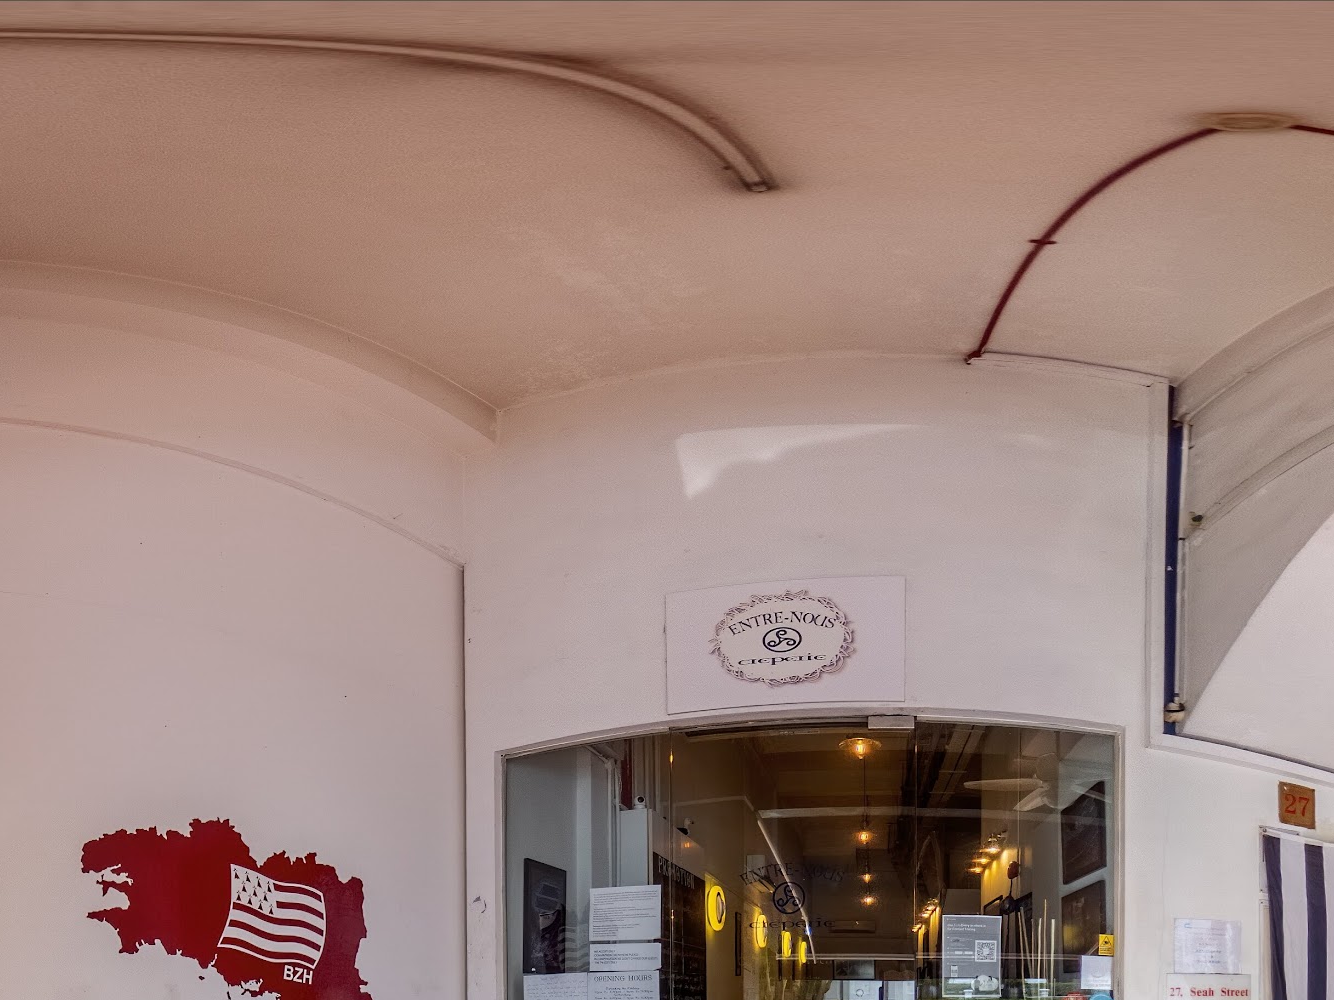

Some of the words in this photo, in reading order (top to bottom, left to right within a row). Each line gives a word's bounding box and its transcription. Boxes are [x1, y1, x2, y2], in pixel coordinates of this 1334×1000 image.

[728, 610, 837, 636] ENTRE-NOUS
[1283, 794, 1310, 818] 27
[283, 964, 313, 985] BZH
[1190, 987, 1214, 996] Seah
[1220, 987, 1249, 996] Street
